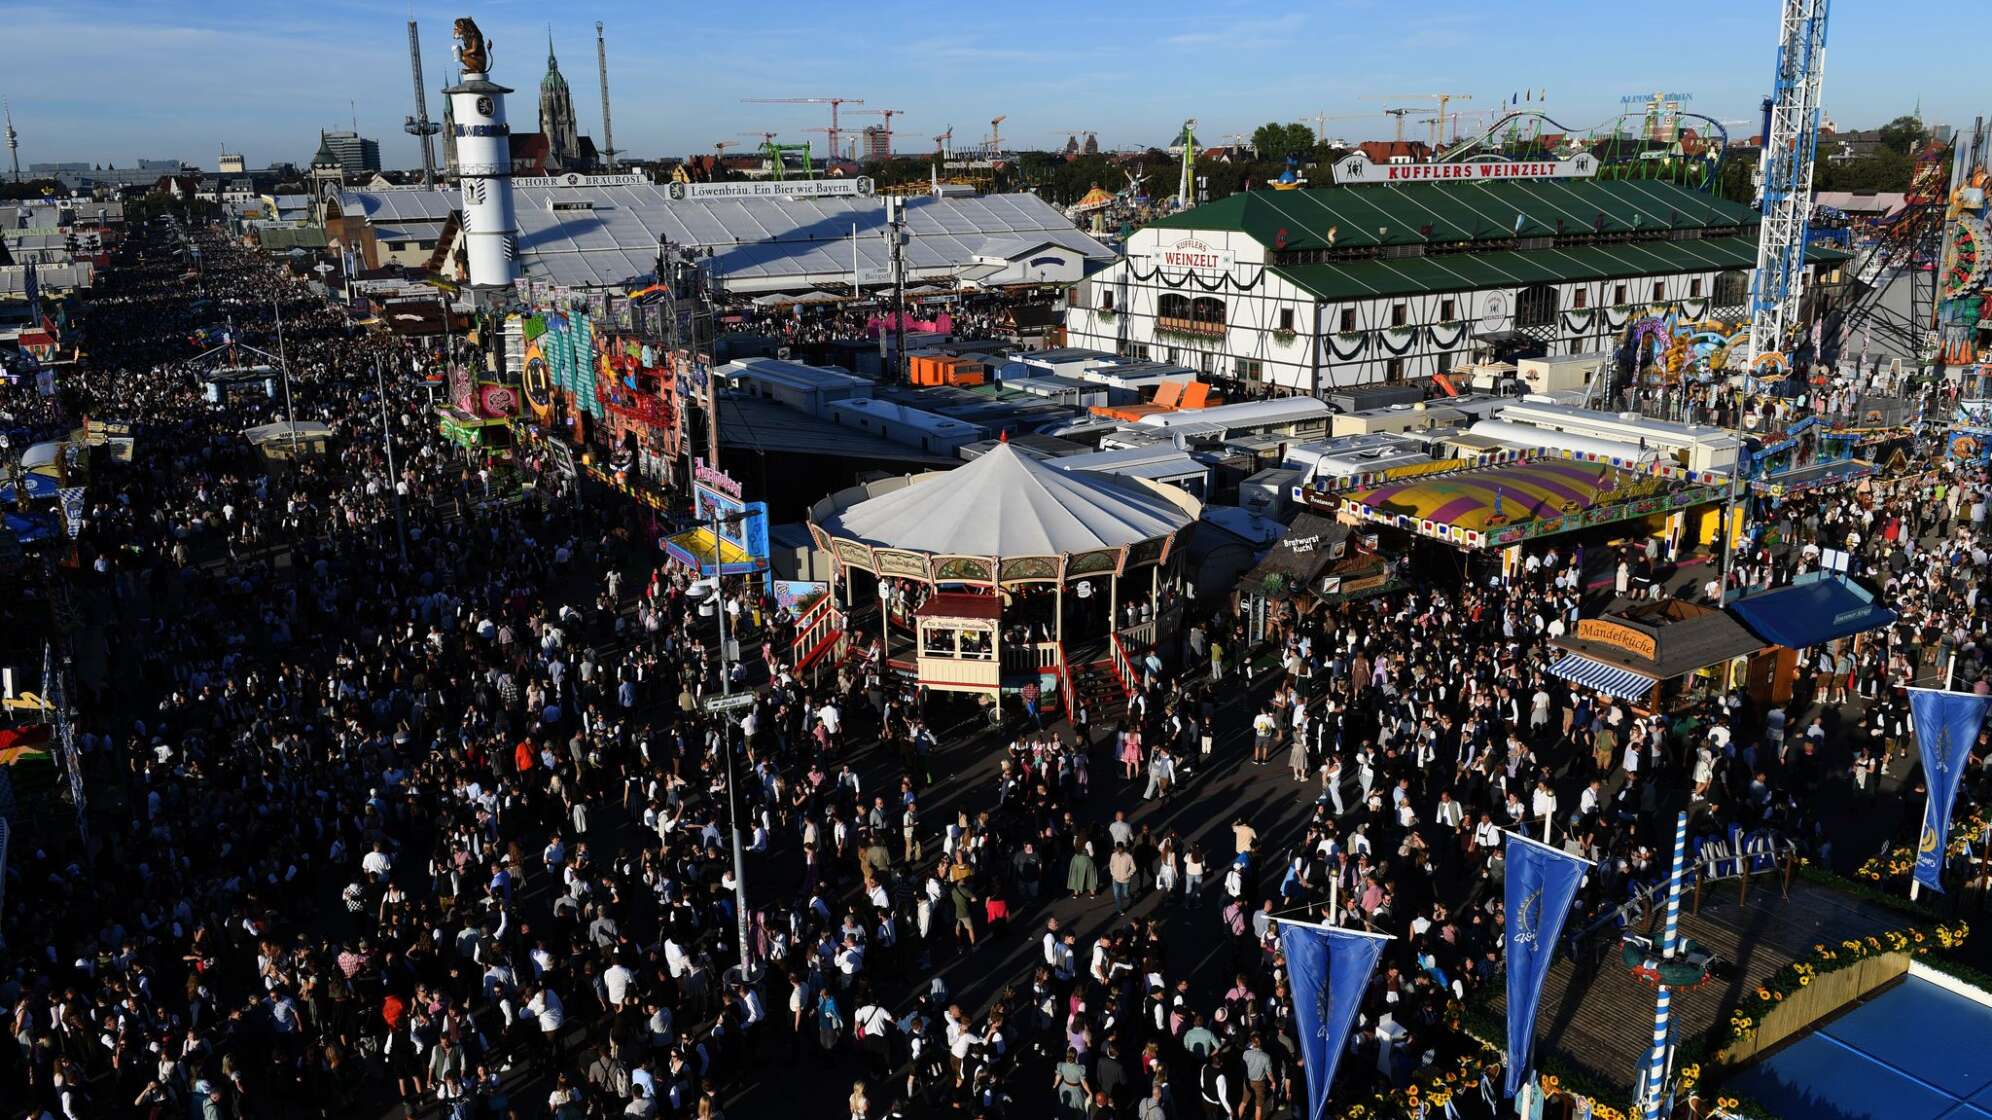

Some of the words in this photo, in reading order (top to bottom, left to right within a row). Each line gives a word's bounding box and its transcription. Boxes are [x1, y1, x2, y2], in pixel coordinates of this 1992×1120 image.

[1388, 165, 1472, 180] KUFFLERS
[1480, 163, 1556, 177] WEINZELT
[691, 184, 750, 197] Löwenbräu.
[754, 184, 770, 194] Ein
[774, 183, 794, 194] Bier
[796, 183, 813, 193] wie
[816, 182, 852, 195] Bayern.
[1176, 240, 1207, 252] KUFFLERS
[1165, 252, 1219, 268] WEINZELT
[1283, 534, 1319, 548] Bratwurst
[1581, 623, 1653, 653] Mandelküche
